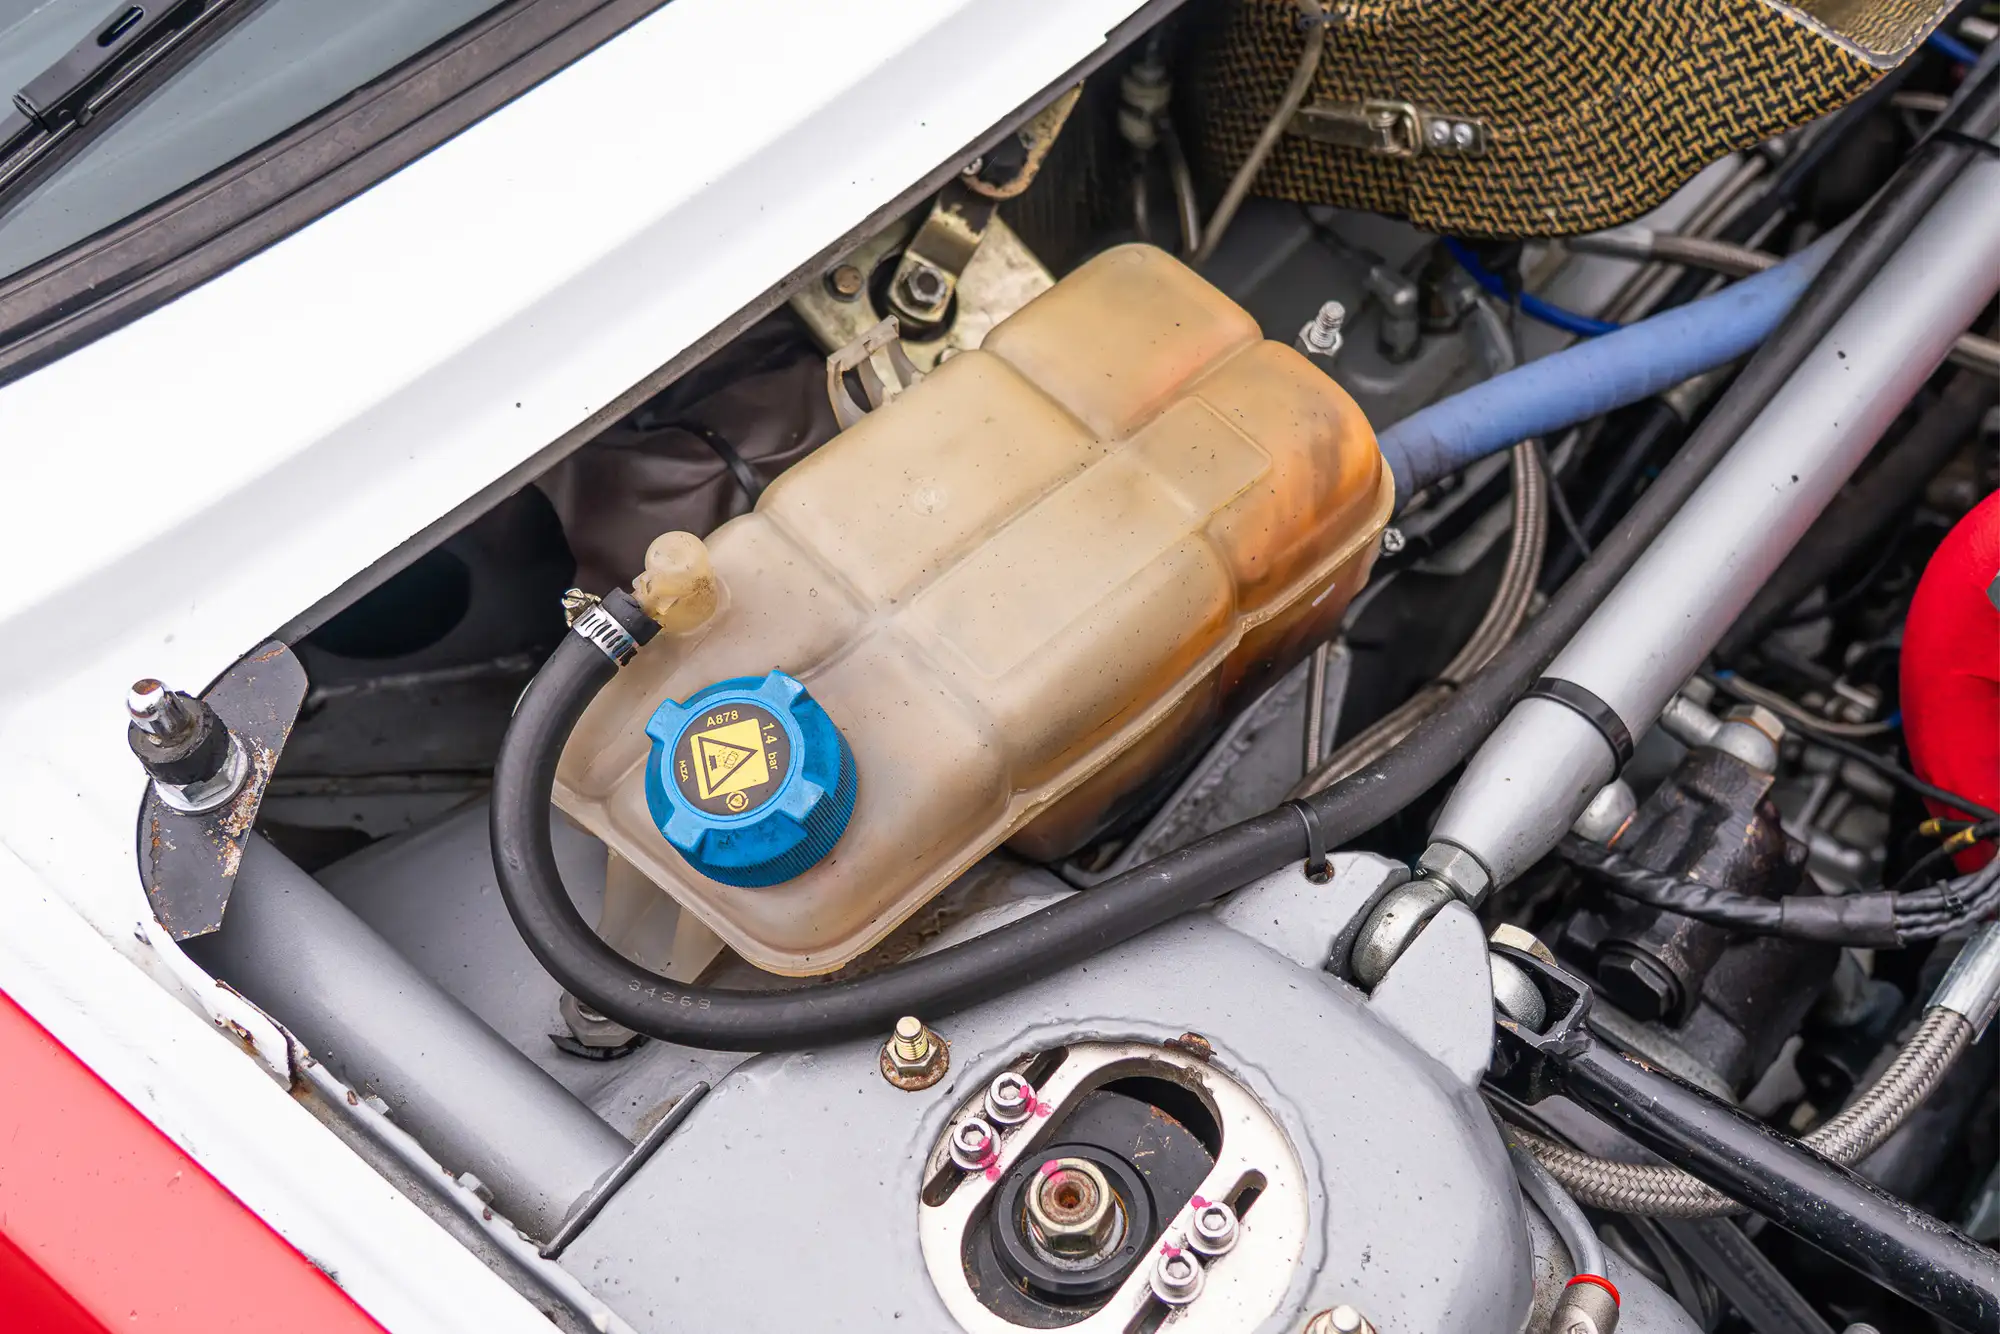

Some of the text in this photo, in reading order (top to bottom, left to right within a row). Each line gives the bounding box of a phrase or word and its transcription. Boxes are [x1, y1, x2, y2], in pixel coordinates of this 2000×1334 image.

[706, 710, 739, 727] A878
[762, 722, 779, 771] 1.4 bar
